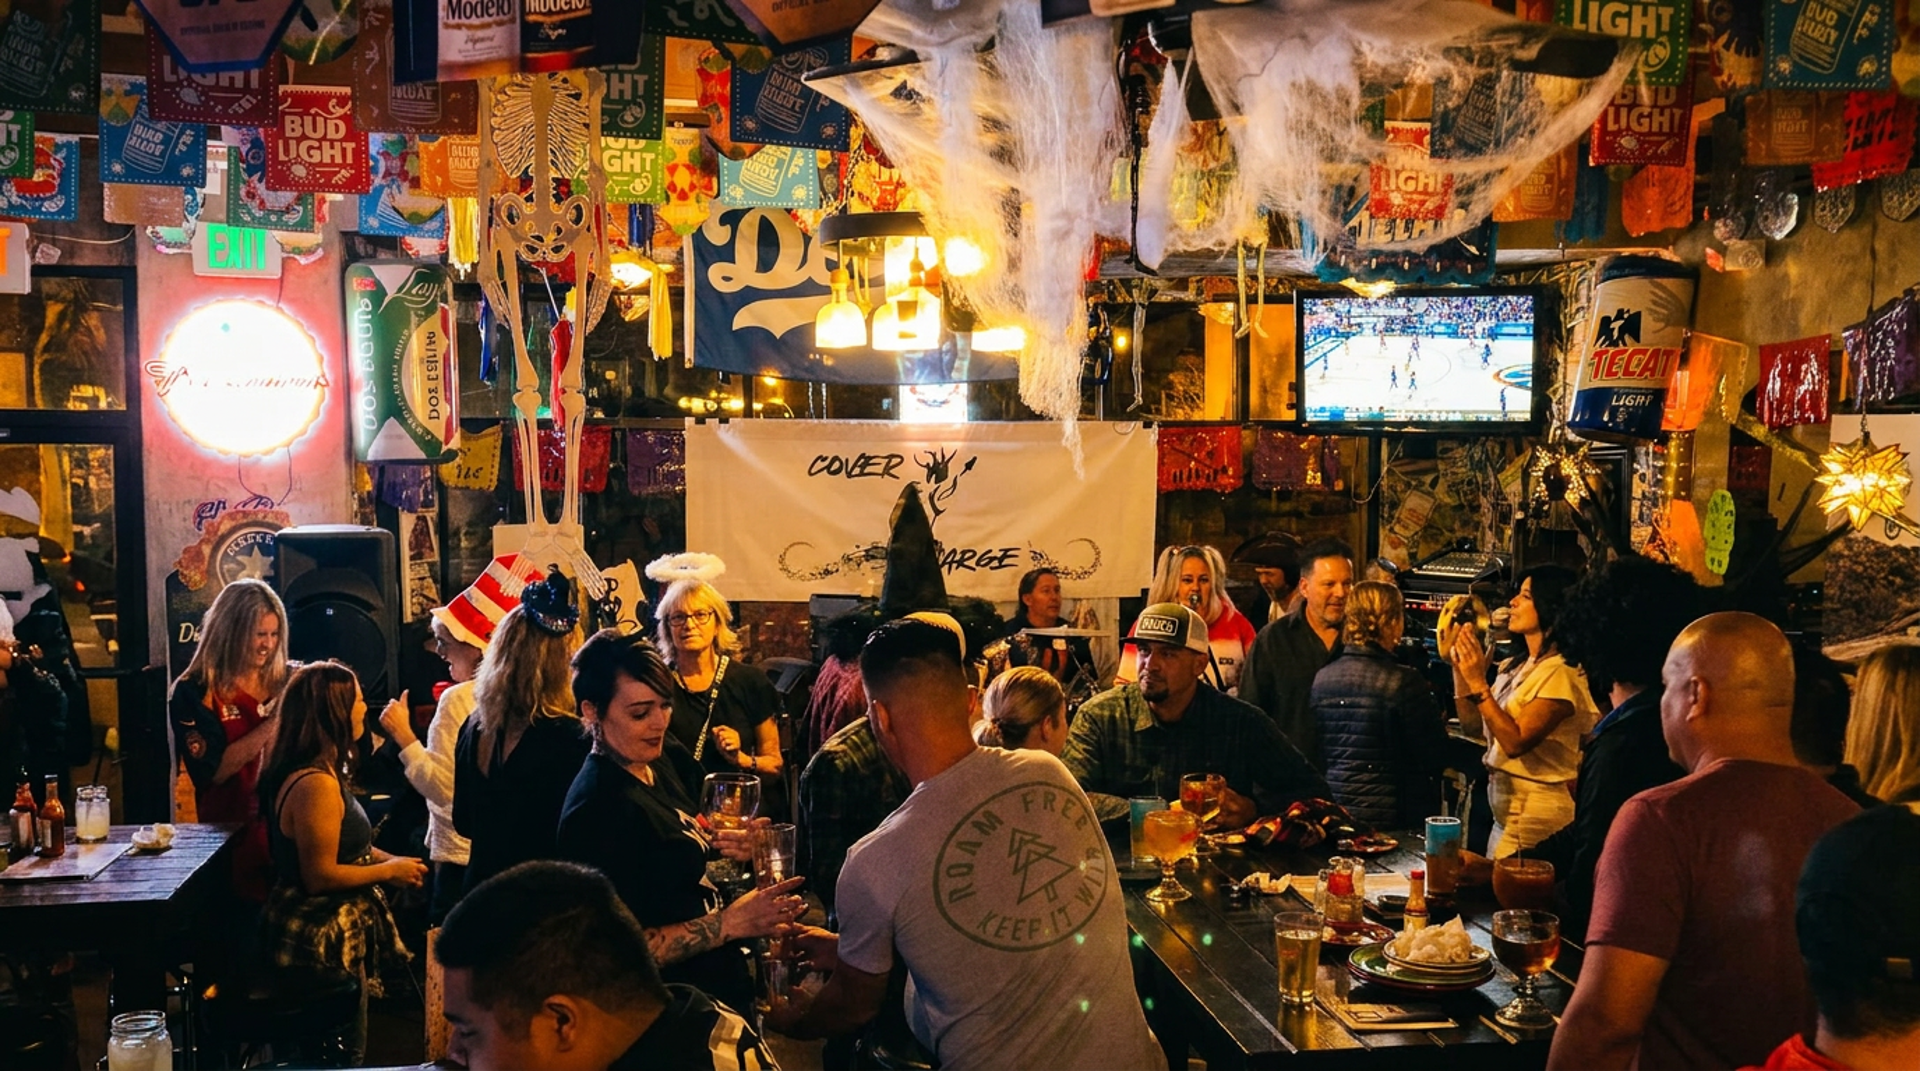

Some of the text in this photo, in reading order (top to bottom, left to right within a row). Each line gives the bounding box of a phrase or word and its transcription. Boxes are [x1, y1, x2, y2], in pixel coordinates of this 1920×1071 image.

[1572, 0, 1675, 39] LIGHT
[284, 115, 347, 140] BUD
[1607, 106, 1684, 133] LIGHT
[278, 139, 356, 164] LIGHT
[602, 150, 656, 173] GHT
[207, 222, 267, 270] EXIT
[1590, 347, 1681, 381] TECAT
[807, 452, 904, 479] COVER
[935, 543, 1021, 576] ARGE
[945, 791, 1089, 904] ROAM FREE
[976, 909, 1042, 942] KEEP
[1049, 903, 1073, 934] IT
